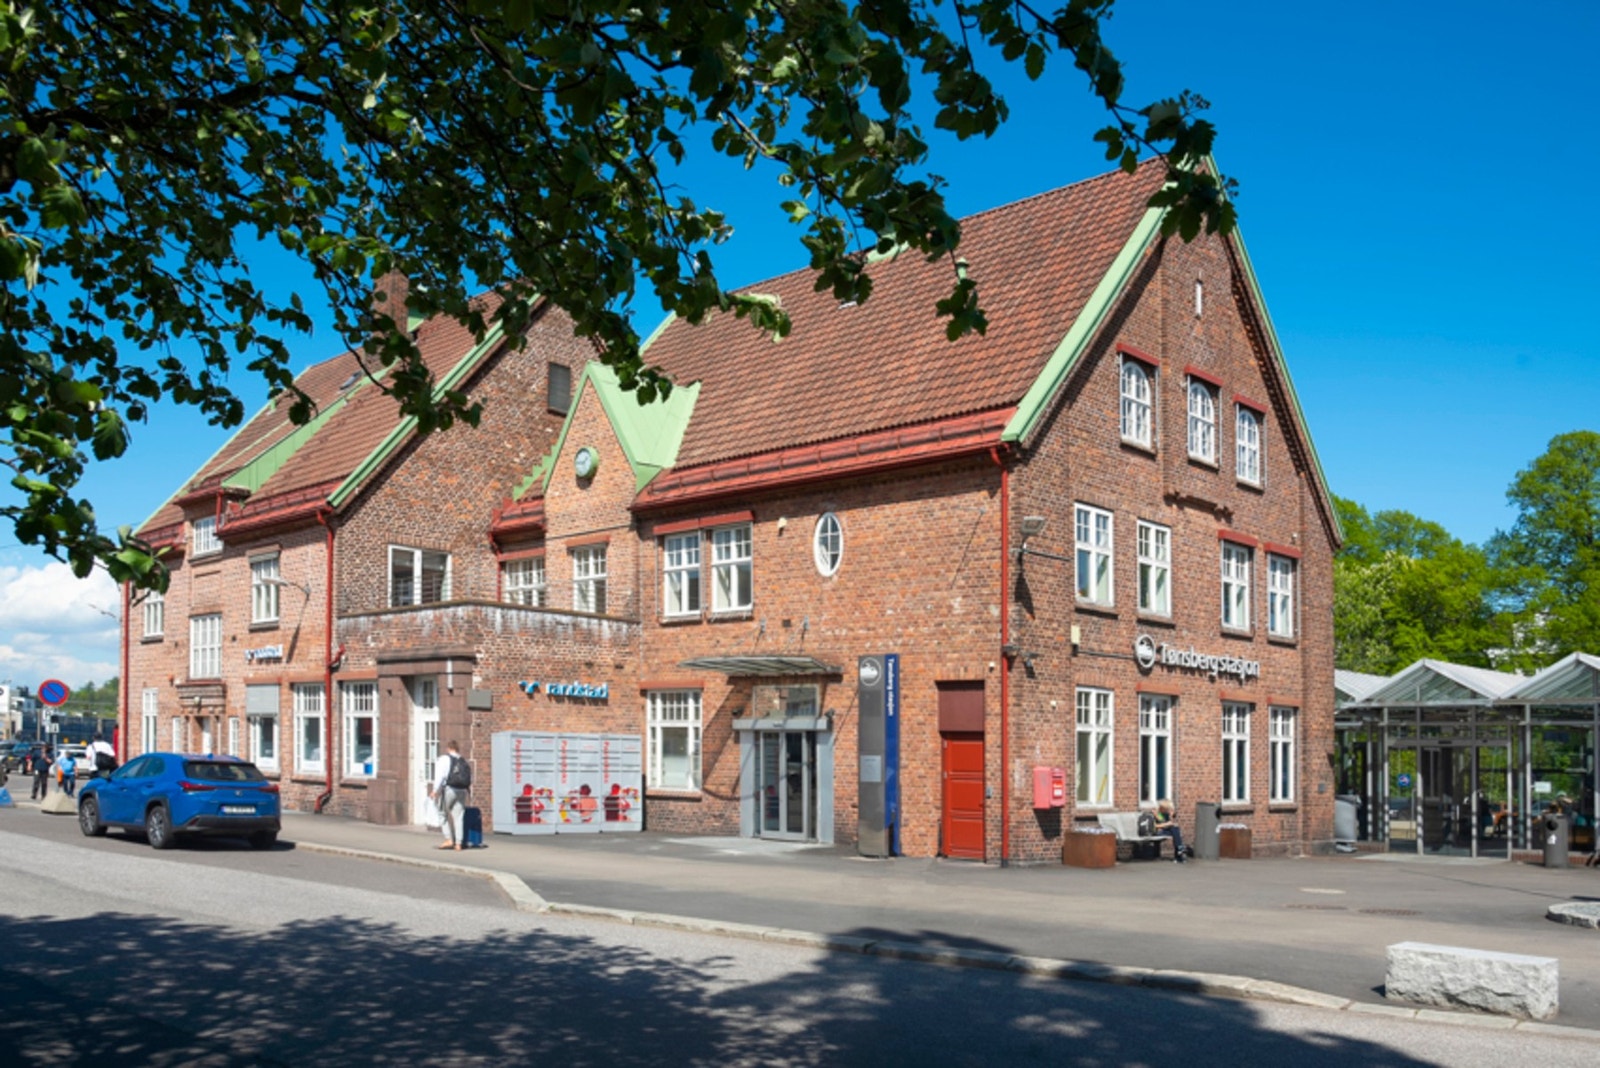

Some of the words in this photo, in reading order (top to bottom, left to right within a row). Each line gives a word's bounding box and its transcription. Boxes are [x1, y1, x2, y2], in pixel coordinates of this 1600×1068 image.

[1161, 643, 1218, 674] Tønsberg
[1219, 654, 1259, 679] stasjon
[546, 681, 608, 698] randstad
